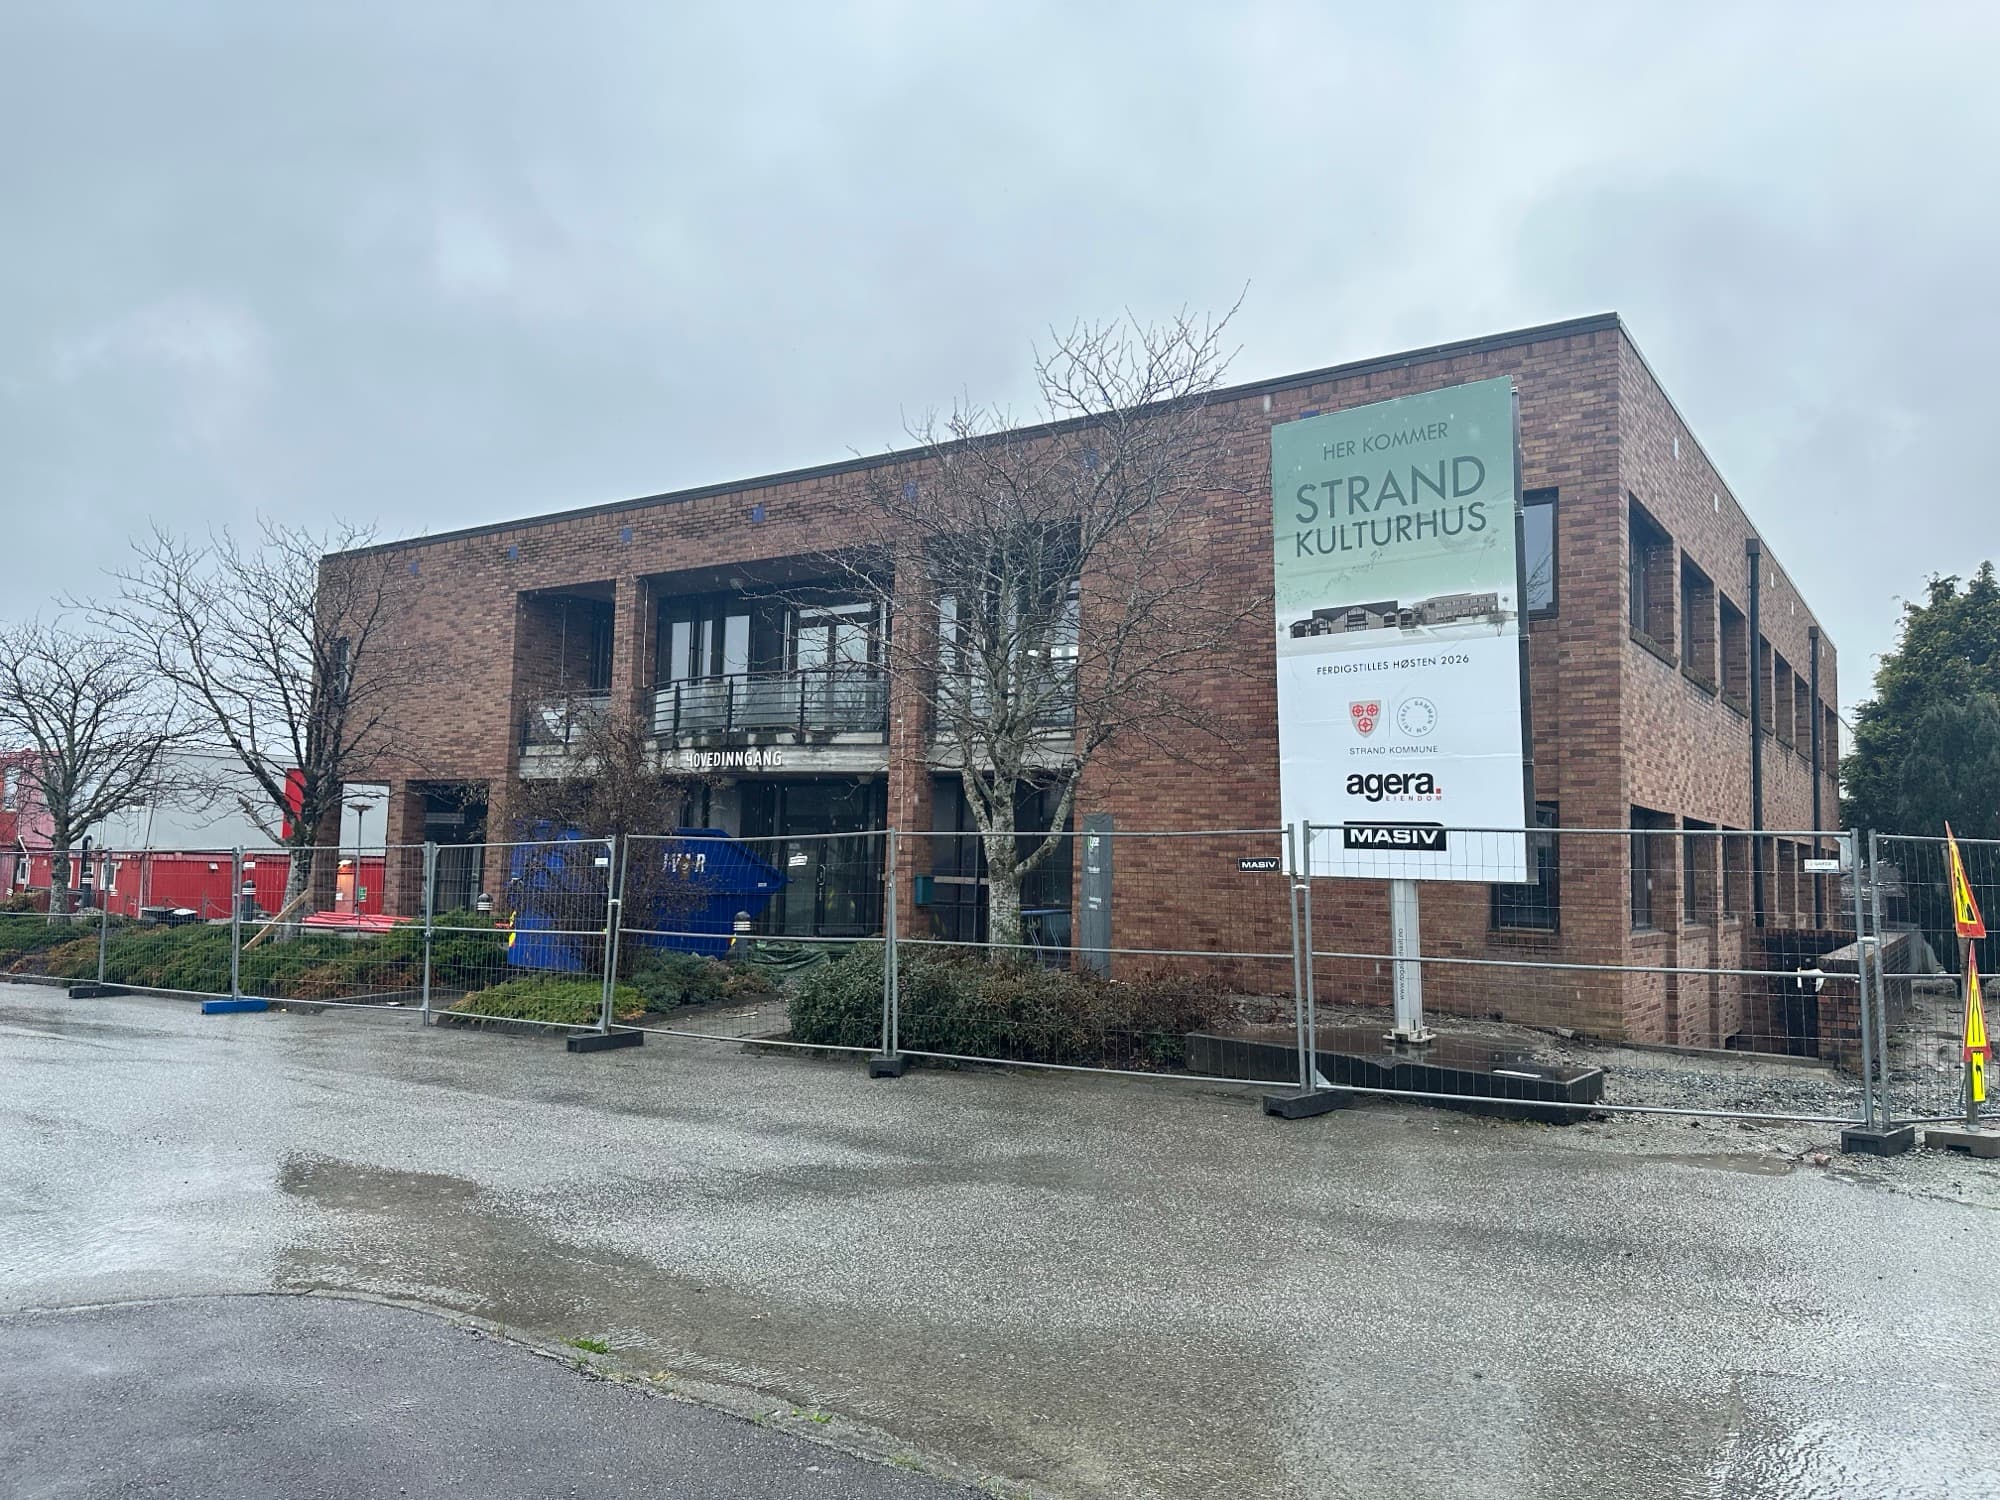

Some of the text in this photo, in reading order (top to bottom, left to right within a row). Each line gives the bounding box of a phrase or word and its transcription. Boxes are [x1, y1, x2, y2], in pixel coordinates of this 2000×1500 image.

[1323, 422, 1448, 461] HER KOMMER
[1295, 455, 1485, 524] STRAND
[1296, 502, 1487, 557] KULTURHUS
[1316, 654, 1469, 675] FERDIGSTILLES HØSTEN 2026
[1349, 745, 1439, 755] STRAND KOMMUNE
[1350, 828, 1438, 844] MASIV
